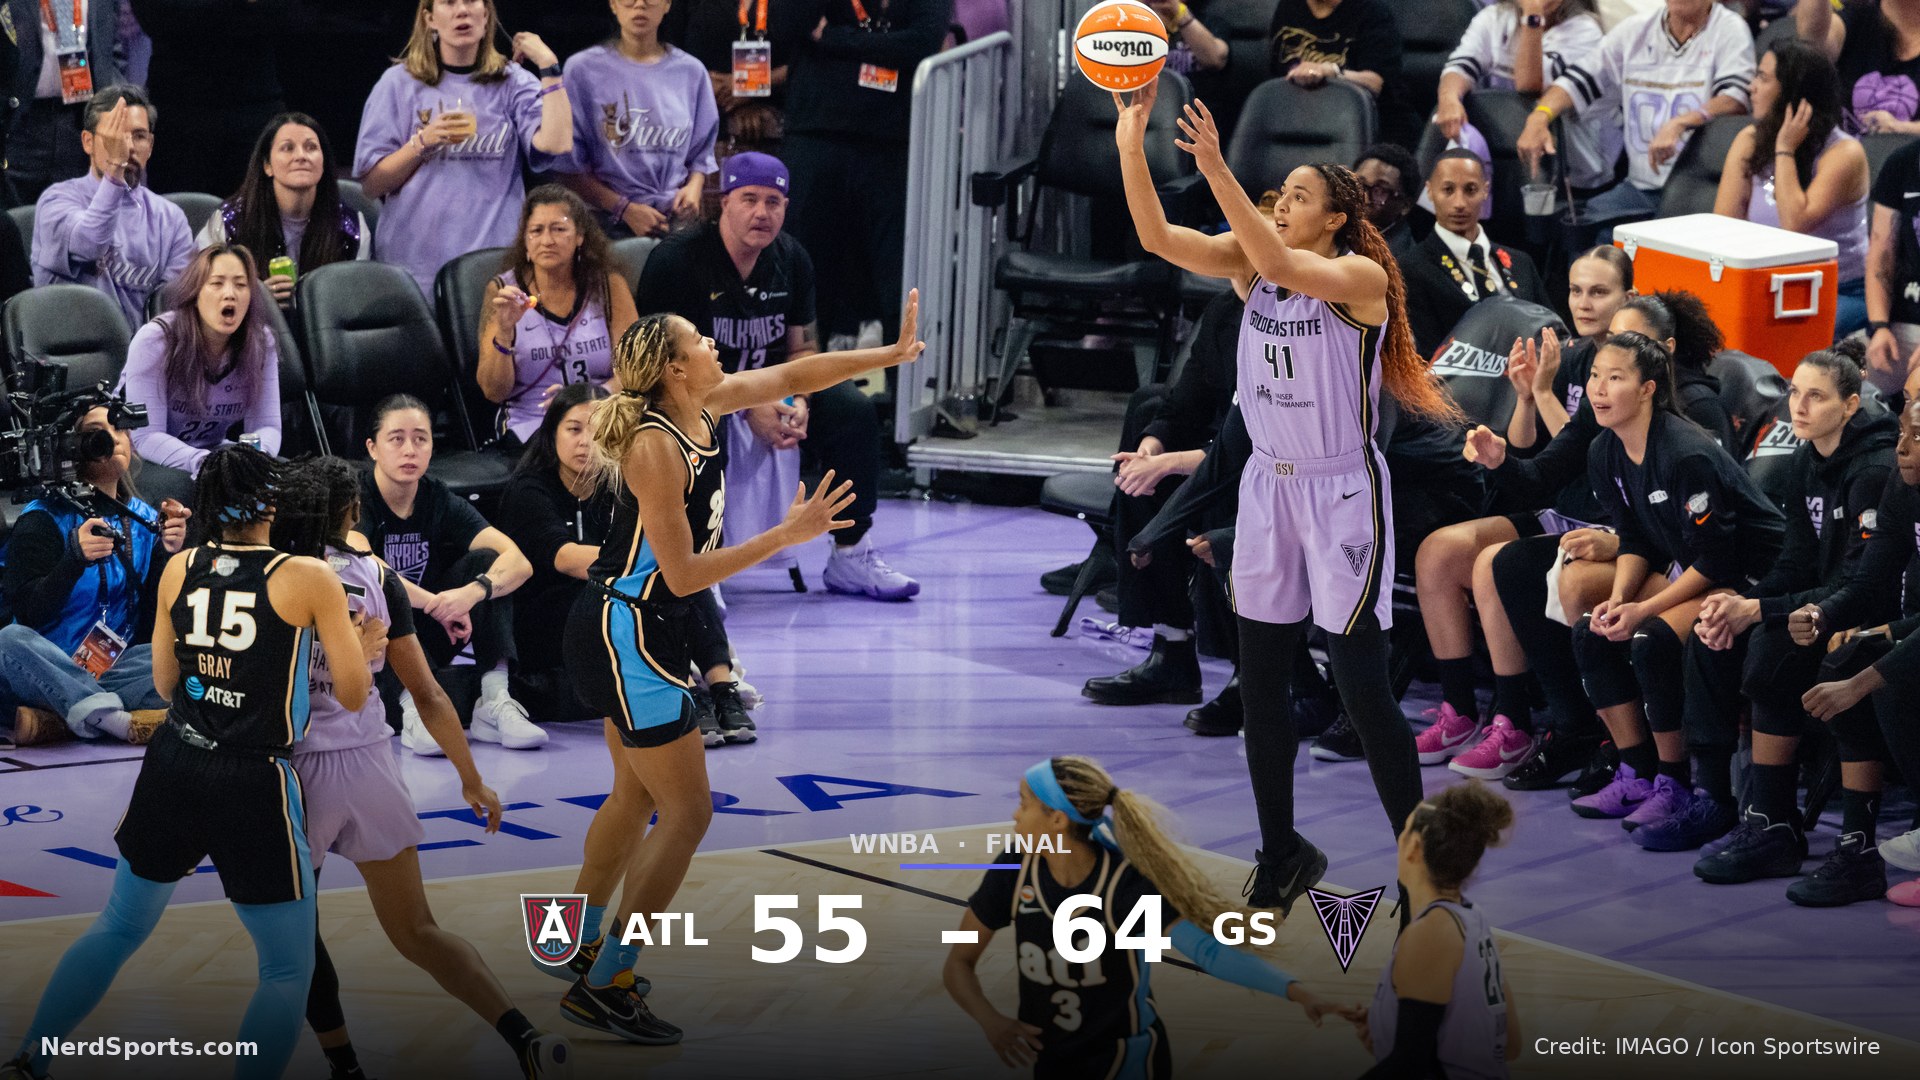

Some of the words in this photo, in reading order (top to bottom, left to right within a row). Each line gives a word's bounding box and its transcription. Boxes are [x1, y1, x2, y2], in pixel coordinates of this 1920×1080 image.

[1092, 40, 1153, 57] Wilson
[713, 313, 786, 349] VALKYRIES
[1280, 319, 1322, 337] STATE
[576, 336, 608, 355] STATE
[1434, 340, 1508, 374] FINALS
[1264, 341, 1295, 380] 41
[178, 420, 220, 442] 22
[1275, 462, 1294, 476] GSV
[185, 587, 257, 651] 15
[198, 653, 232, 680] GRAY
[204, 685, 246, 709] AT&T
[1051, 990, 1082, 1032] 3
